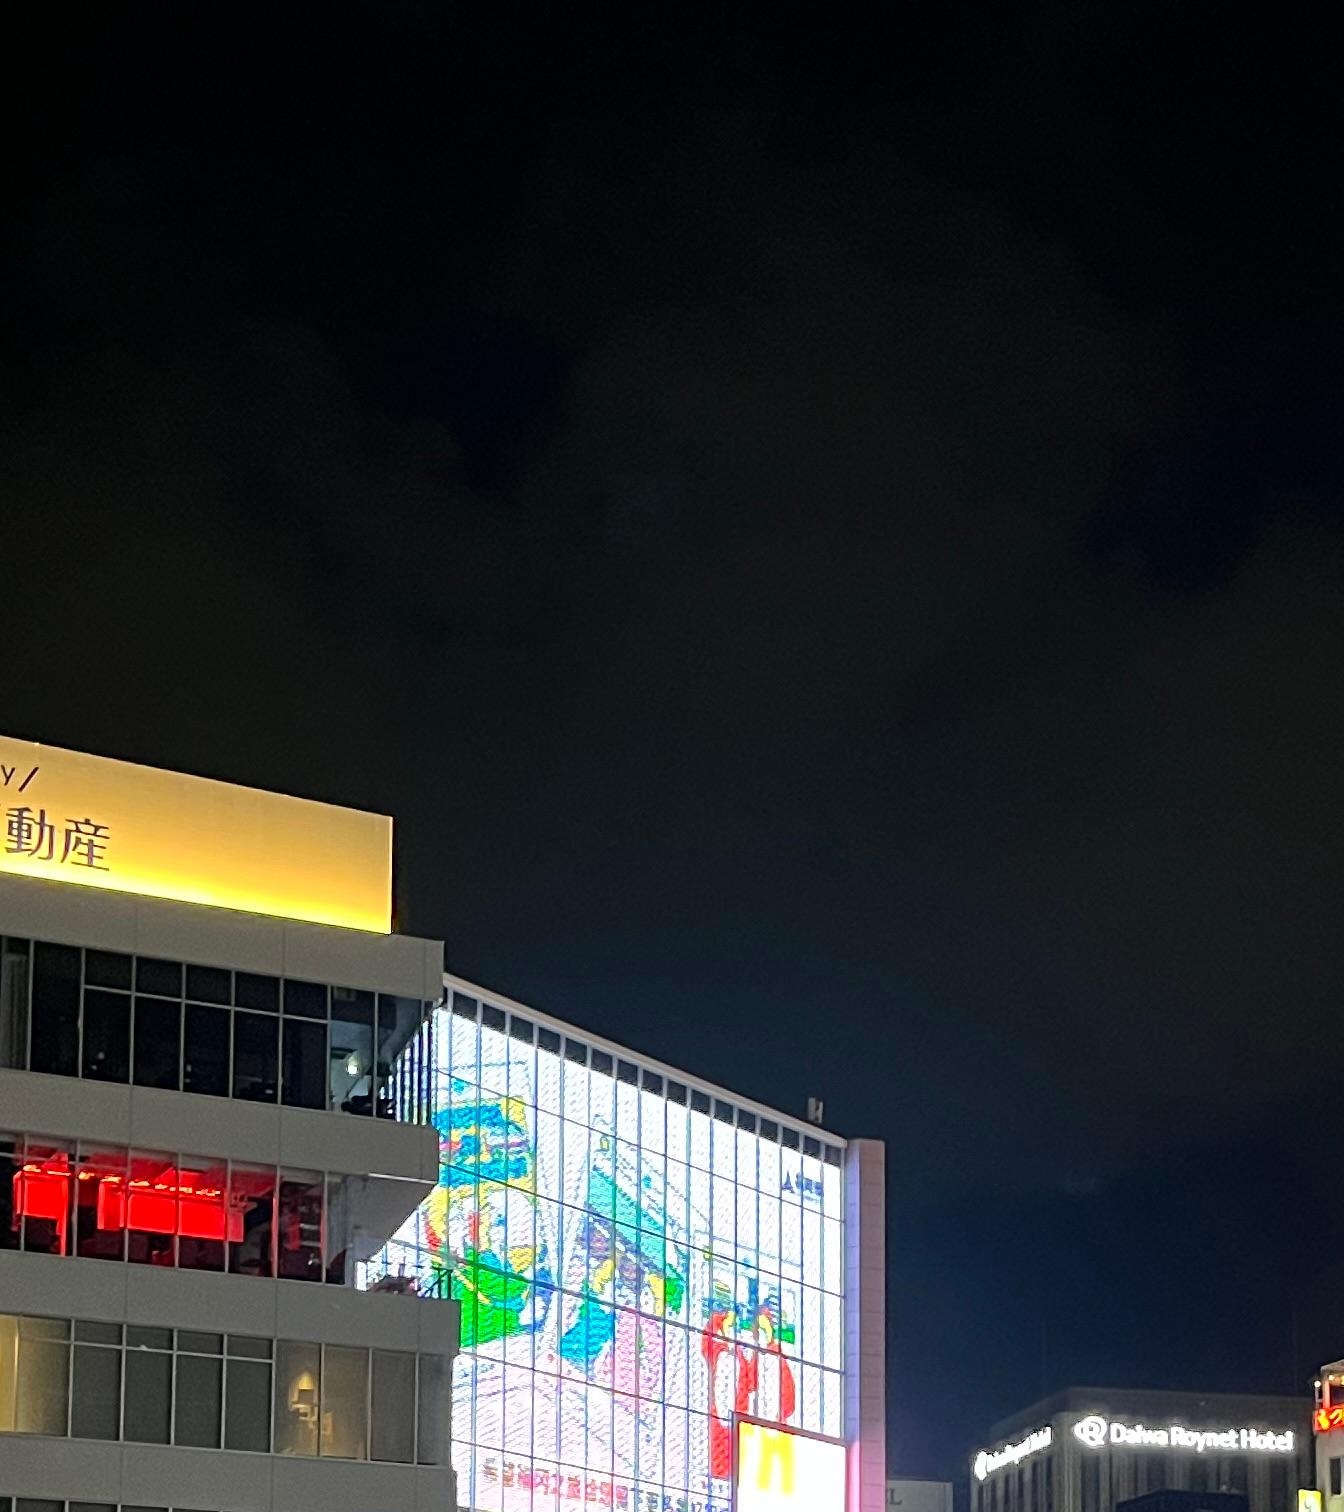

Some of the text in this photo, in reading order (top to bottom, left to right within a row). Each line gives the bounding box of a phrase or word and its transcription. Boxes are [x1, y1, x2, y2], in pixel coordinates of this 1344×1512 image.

[1110, 1422, 1294, 1453] Daiwa Roynet Hotel
